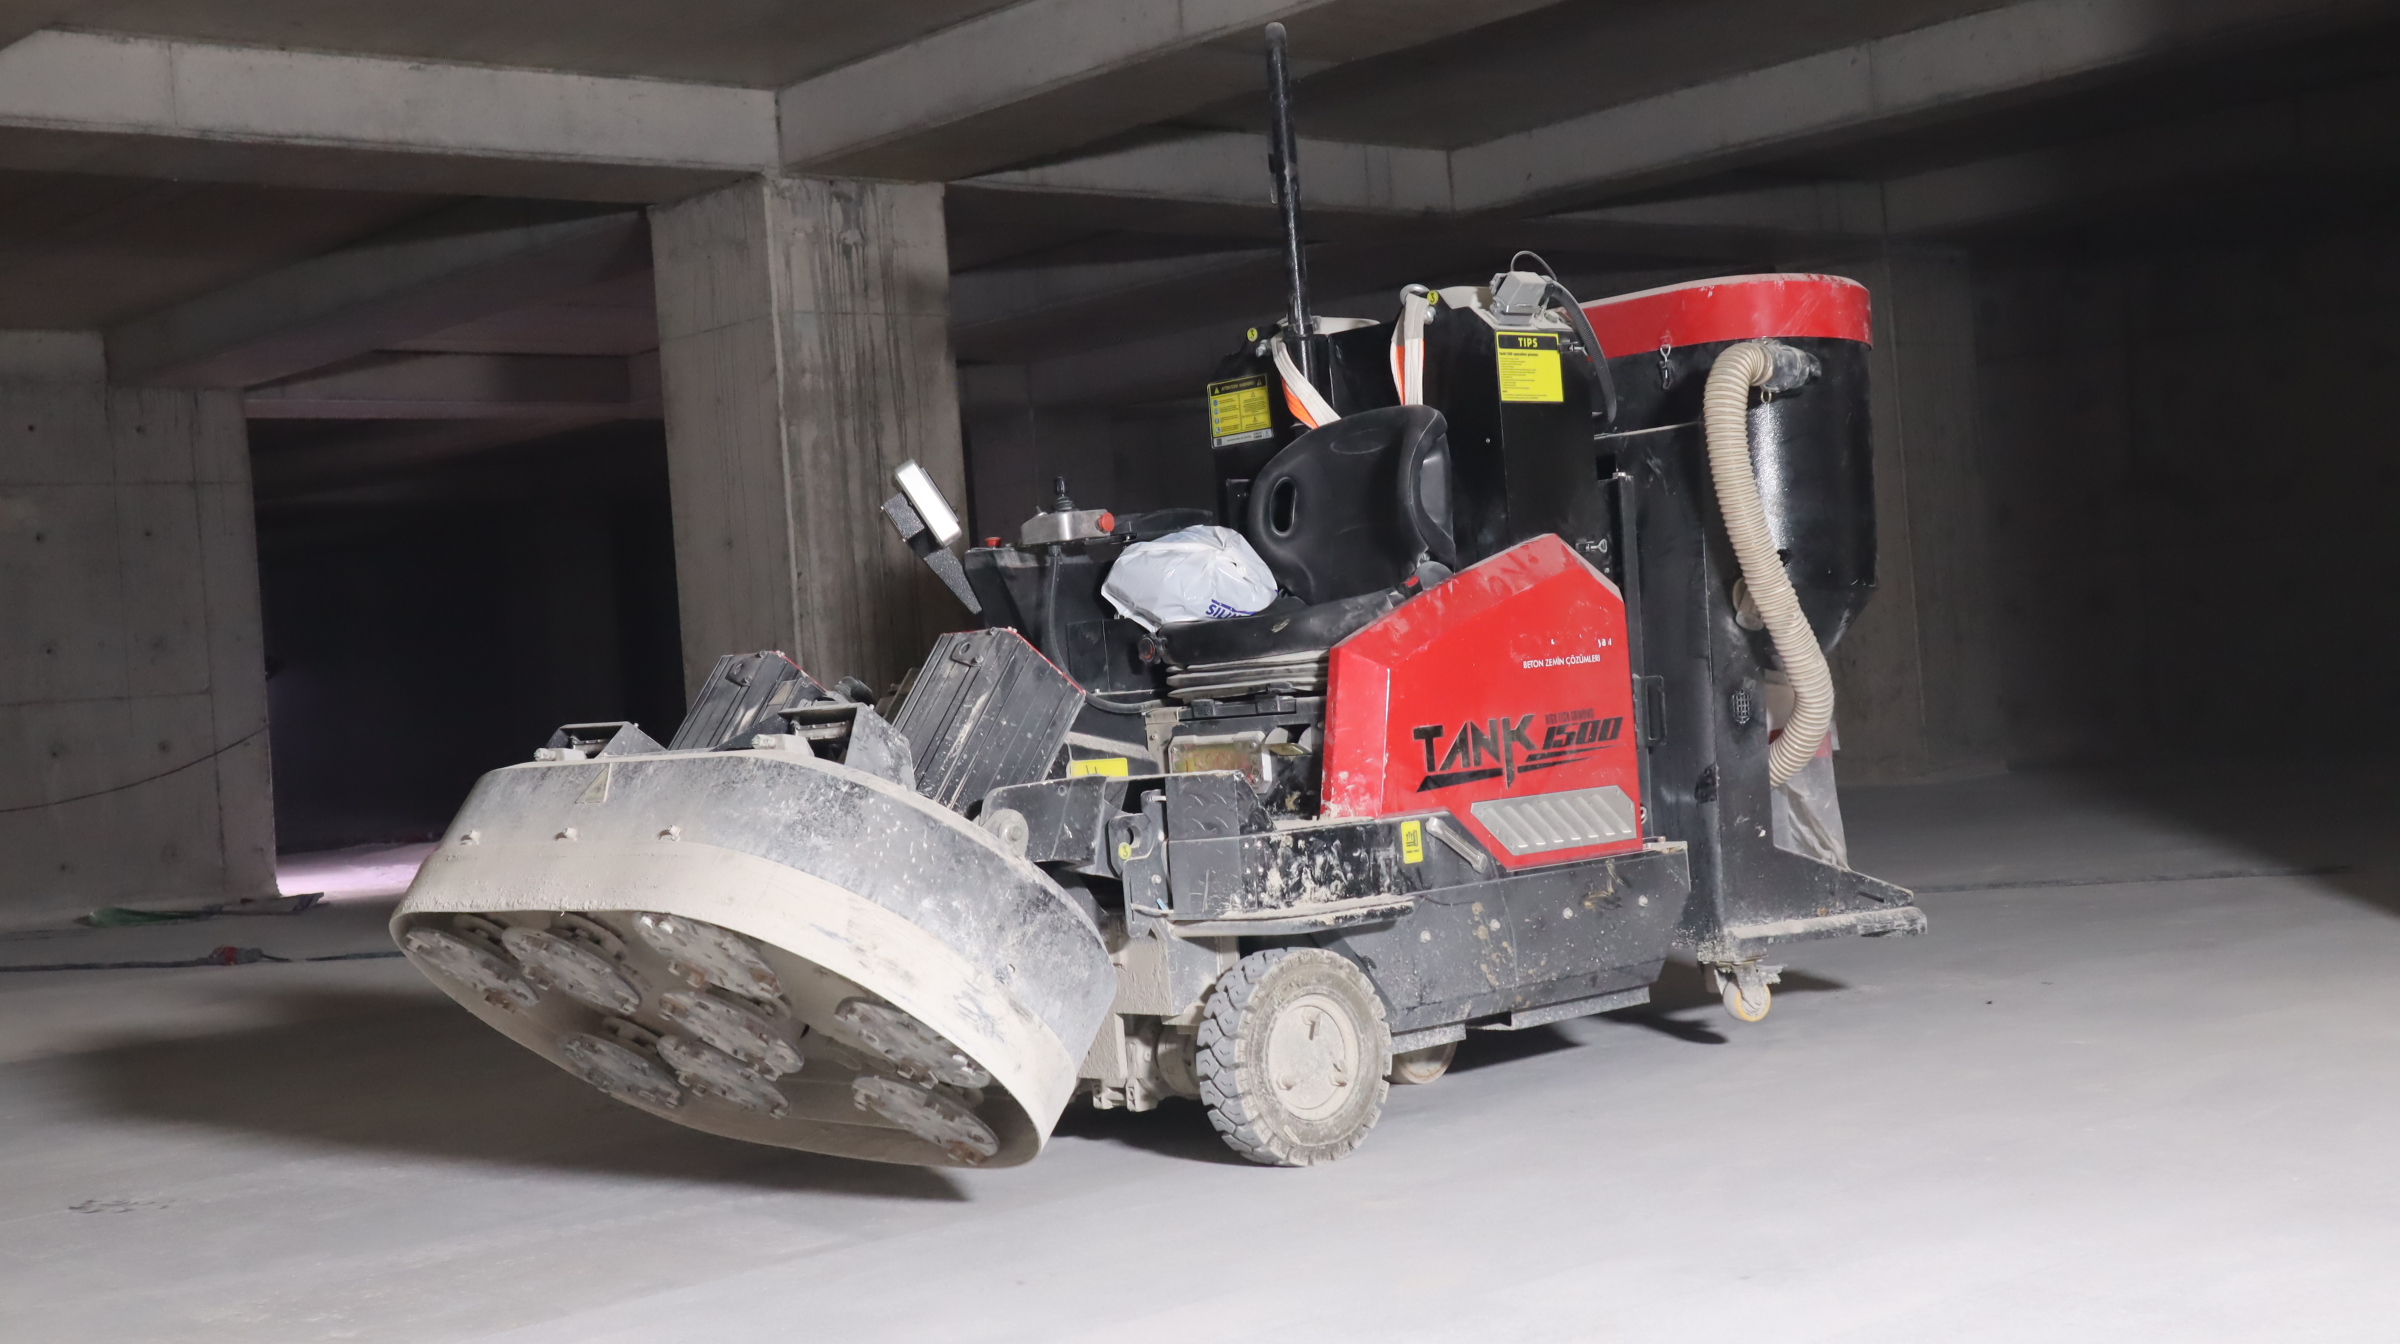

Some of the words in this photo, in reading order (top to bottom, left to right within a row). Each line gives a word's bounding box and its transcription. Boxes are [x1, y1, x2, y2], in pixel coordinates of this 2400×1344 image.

[1518, 337, 1538, 348] TIPS
[1523, 659, 1544, 669] BETON
[1545, 656, 1565, 667] ZEMİN
[1413, 714, 1539, 790] TANK
[1542, 717, 1623, 750] 1500
